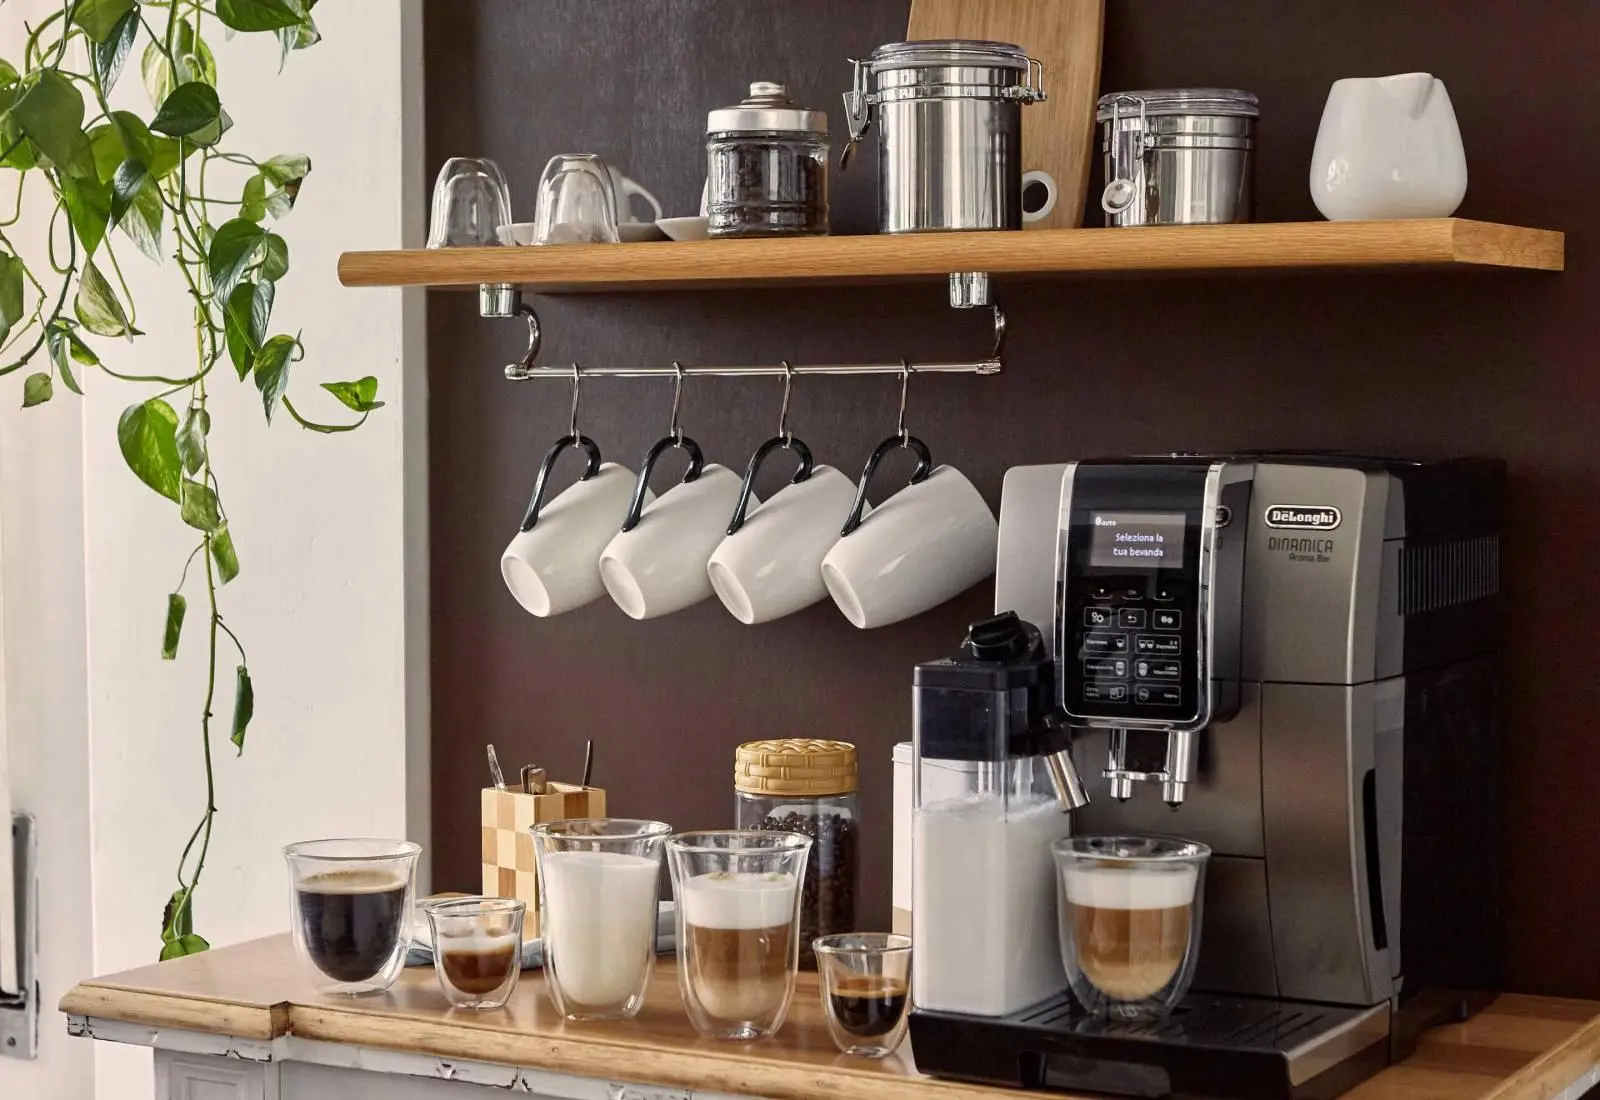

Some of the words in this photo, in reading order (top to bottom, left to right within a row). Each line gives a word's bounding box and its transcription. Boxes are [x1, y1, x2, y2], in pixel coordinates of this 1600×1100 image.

[1115, 533, 1154, 542] Seleziona
[1156, 533, 1164, 543] la
[1268, 536, 1334, 553] DINAMICA
[1113, 547, 1128, 556] tua
[1129, 547, 1164, 557] bevanda
[1289, 552, 1315, 562] Aroma
